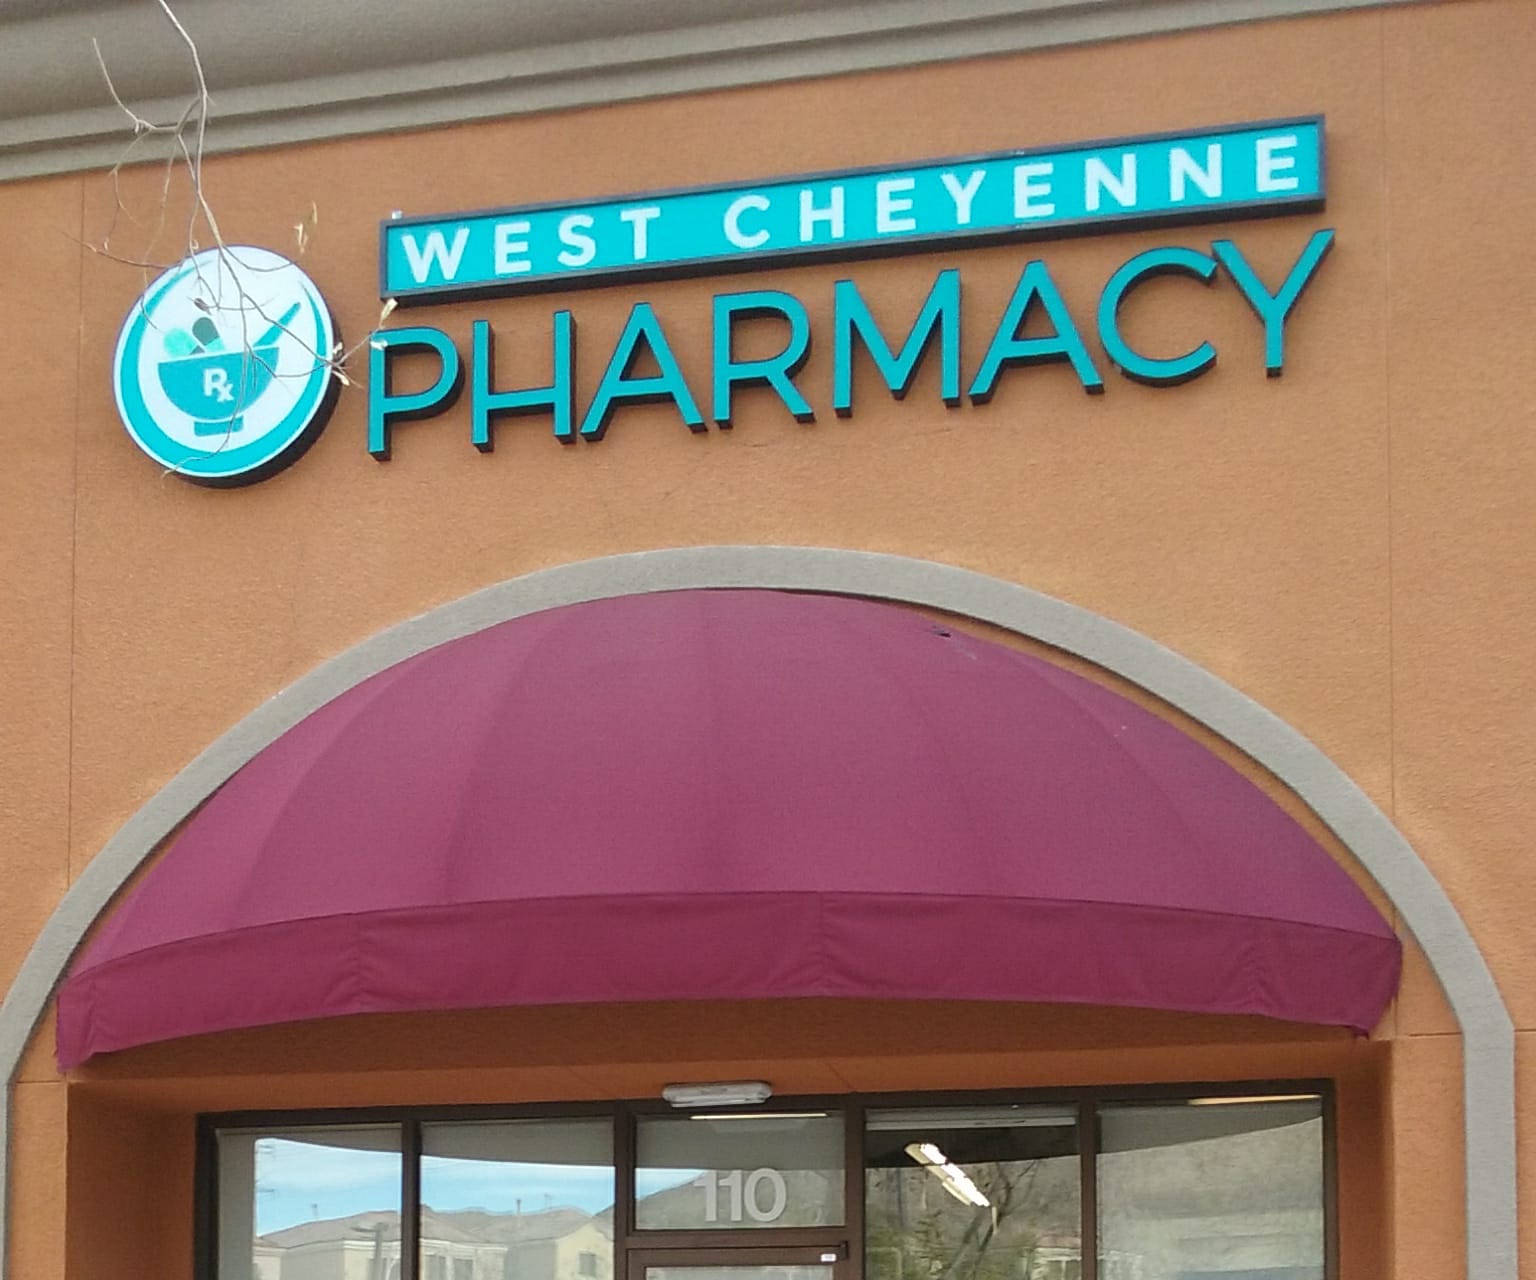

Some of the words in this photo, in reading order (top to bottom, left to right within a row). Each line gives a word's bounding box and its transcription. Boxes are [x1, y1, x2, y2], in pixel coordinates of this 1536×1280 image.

[400, 206, 661, 284] WEST
[723, 134, 1300, 249] CHEYENNE
[367, 229, 1335, 458] PHARMACY
[694, 1168, 788, 1223] 110
